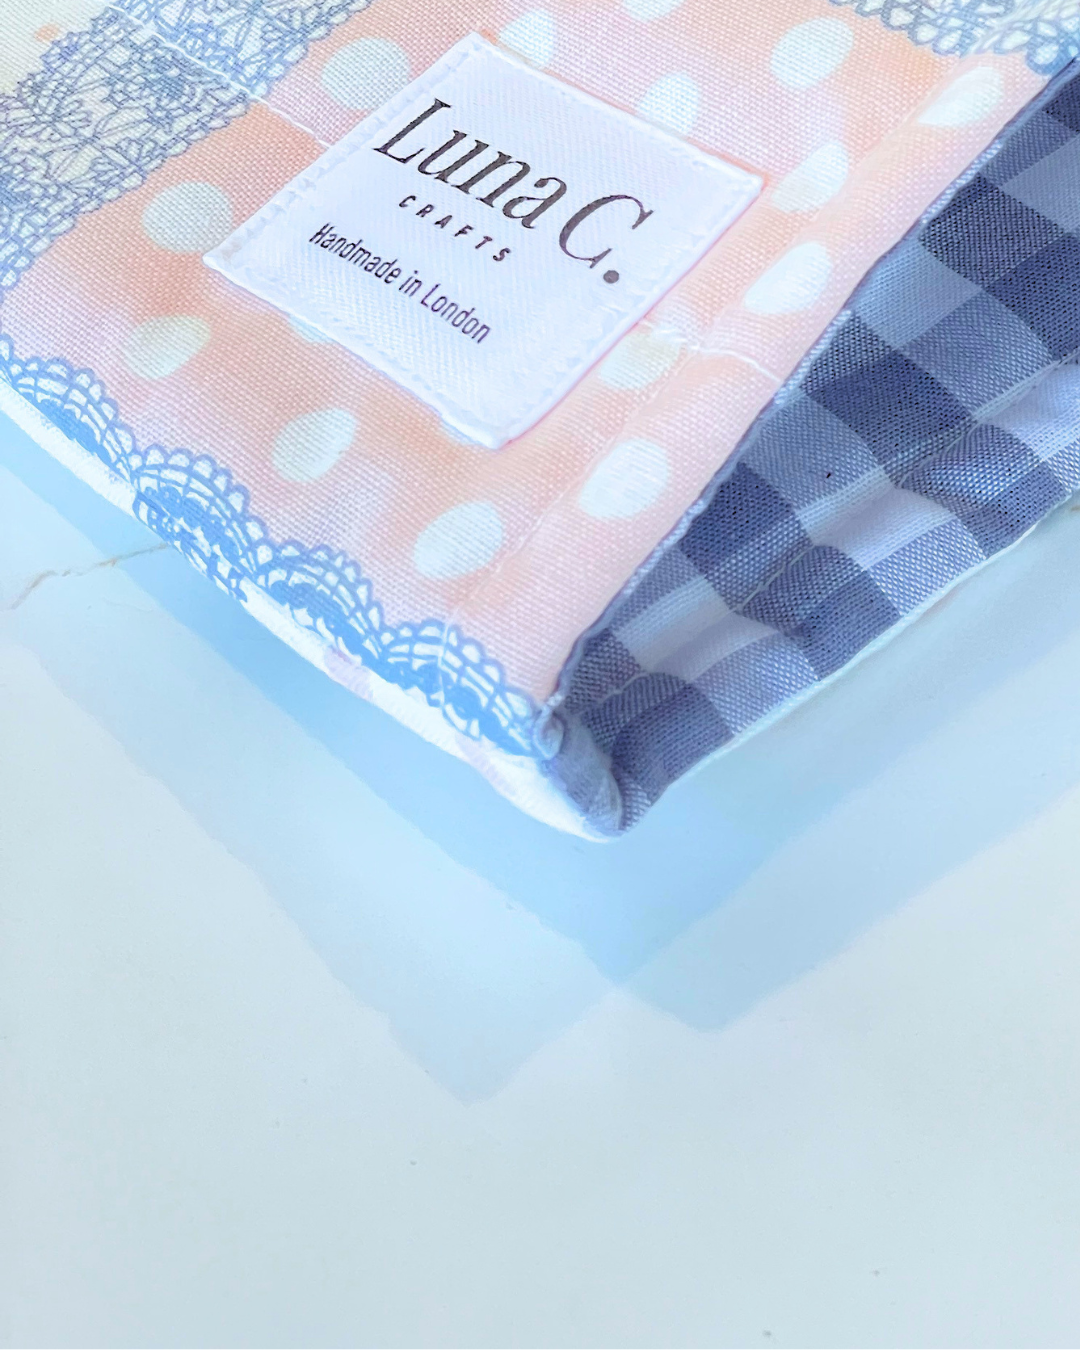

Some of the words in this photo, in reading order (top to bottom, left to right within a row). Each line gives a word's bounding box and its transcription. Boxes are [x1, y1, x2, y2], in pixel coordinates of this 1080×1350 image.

[373, 98, 567, 229] Luna
[558, 194, 654, 284] C.
[398, 195, 511, 262] CRAFTS
[309, 222, 404, 285] Handmade
[398, 270, 423, 298] in
[420, 284, 491, 344] London
